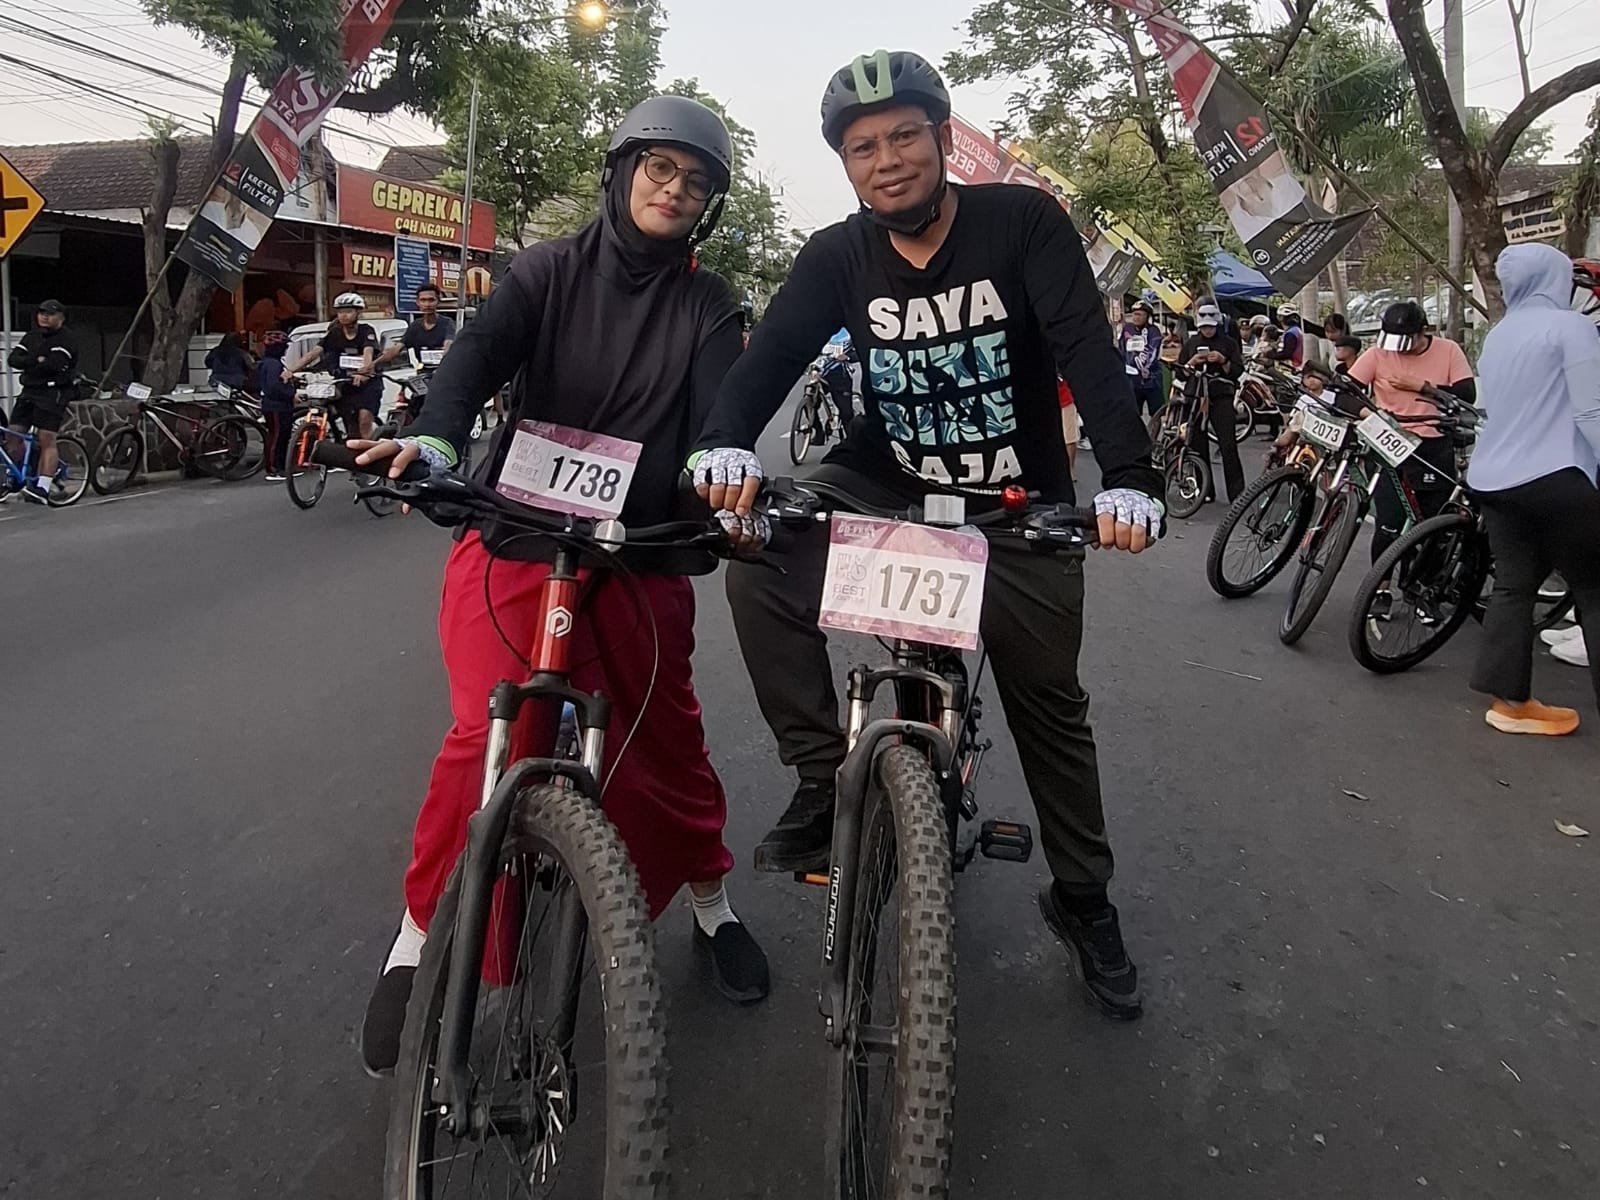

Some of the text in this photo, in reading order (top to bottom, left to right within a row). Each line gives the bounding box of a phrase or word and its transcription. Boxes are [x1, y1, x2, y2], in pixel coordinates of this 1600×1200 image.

[242, 181, 276, 208] FILTER
[246, 173, 280, 198] KRETEK
[371, 179, 448, 220] GEPREK
[419, 220, 456, 239] NGAWI
[351, 253, 386, 278] TEH
[868, 279, 1008, 340] SAYA
[1312, 420, 1341, 443] 2073
[1375, 428, 1409, 458] 1590
[548, 455, 622, 502] 1738
[833, 583, 867, 597] BEST
[879, 563, 971, 619] 1737
